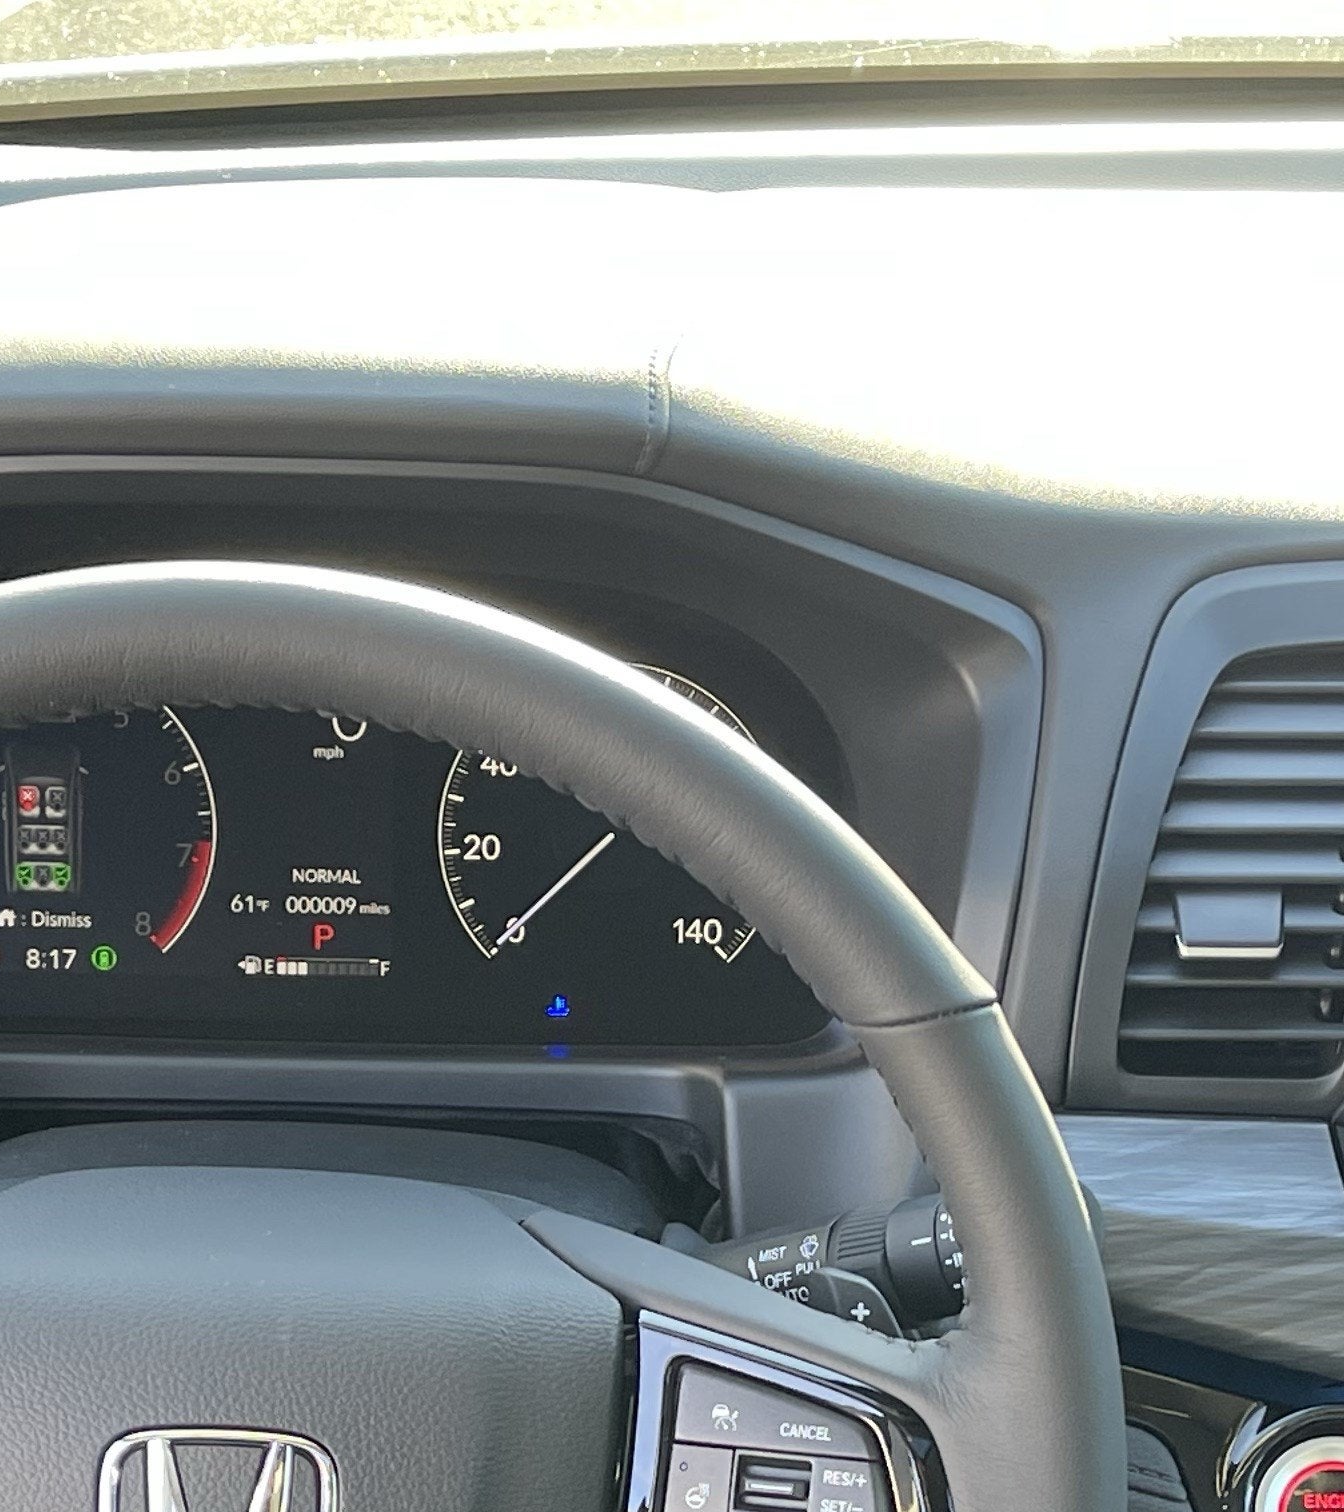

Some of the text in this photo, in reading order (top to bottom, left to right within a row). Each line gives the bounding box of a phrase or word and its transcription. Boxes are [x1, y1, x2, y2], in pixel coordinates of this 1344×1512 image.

[312, 745, 345, 761] mph
[164, 761, 182, 785] 6
[176, 843, 193, 868] 7
[463, 834, 502, 861] 20
[291, 868, 362, 885] NORMAL
[285, 895, 357, 915] 000009
[31, 909, 93, 929] Dismiss
[134, 911, 151, 936] 8
[312, 922, 337, 951] P
[671, 917, 724, 946] 140
[24, 948, 77, 972] 8:17
[263, 958, 275, 975] E
[379, 960, 392, 977] F
[763, 1271, 793, 1290] OFF
[779, 1422, 832, 1442] CANCEL
